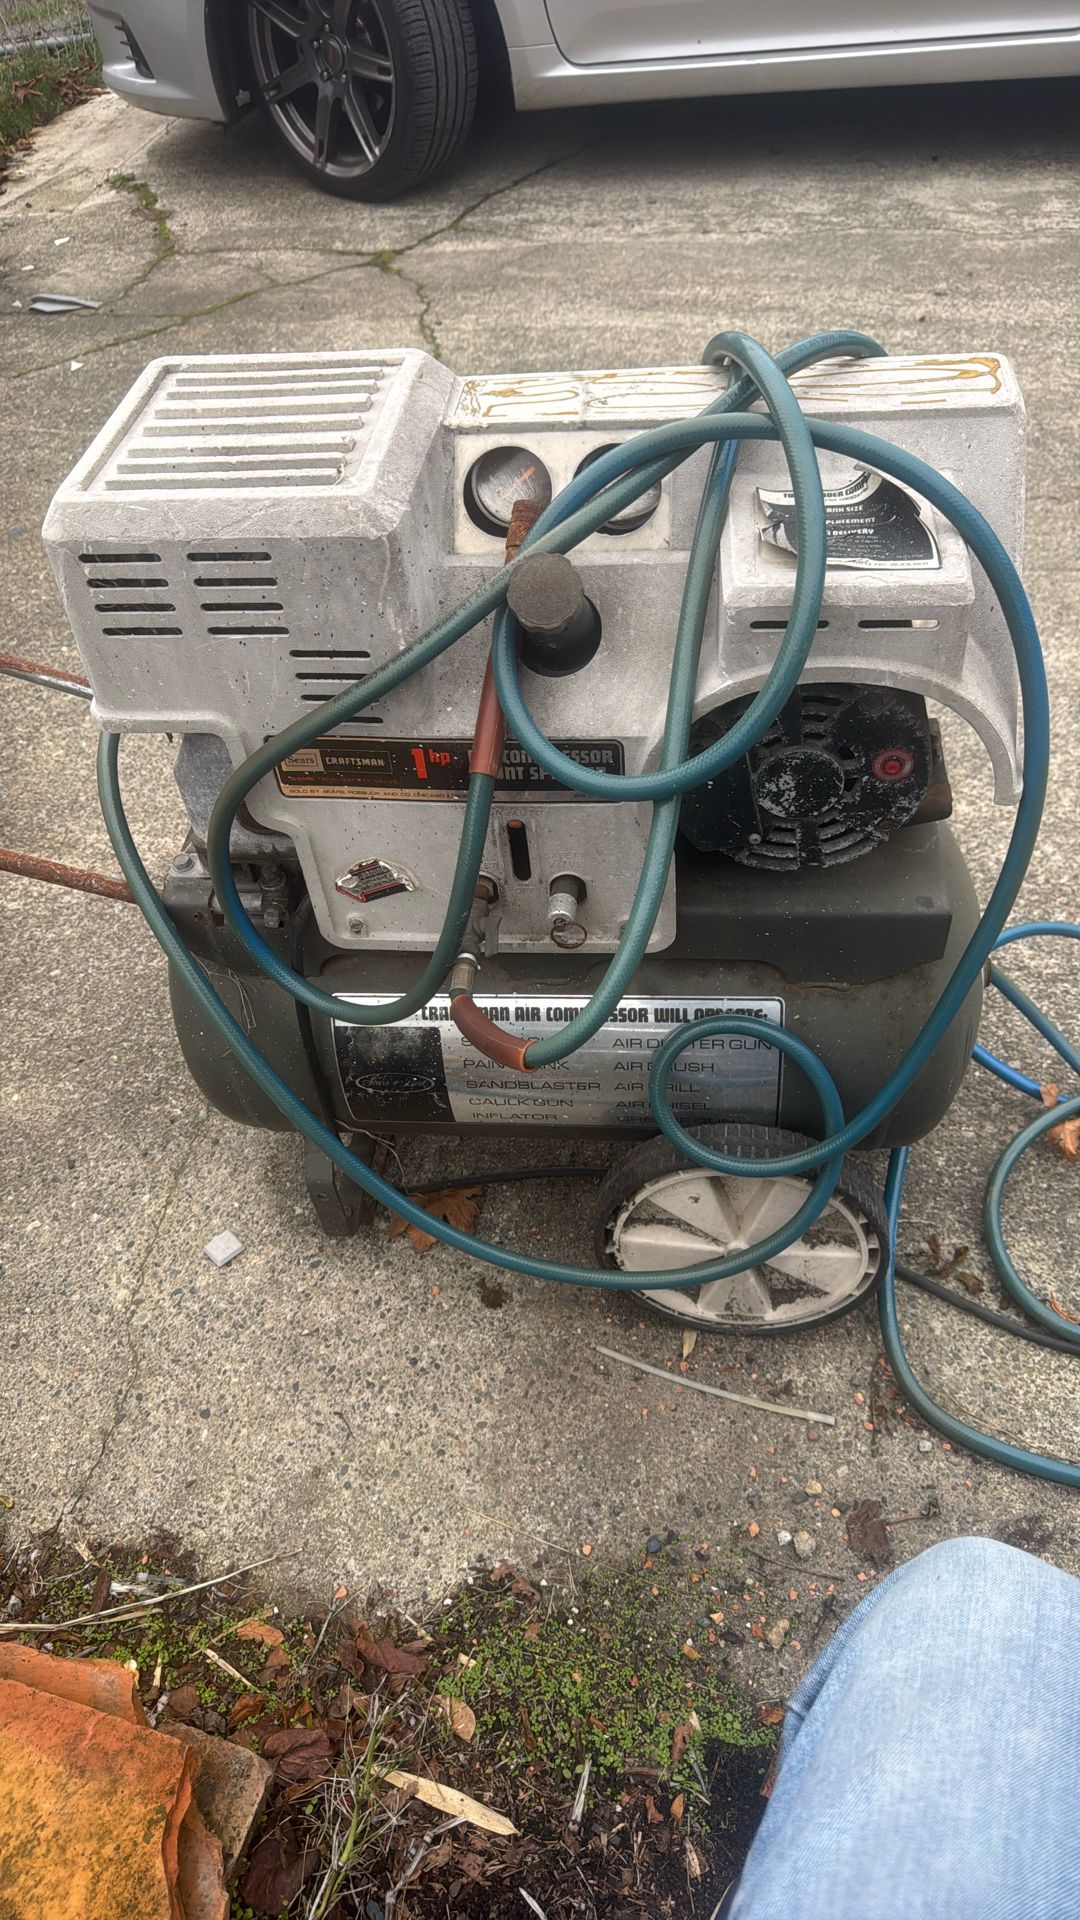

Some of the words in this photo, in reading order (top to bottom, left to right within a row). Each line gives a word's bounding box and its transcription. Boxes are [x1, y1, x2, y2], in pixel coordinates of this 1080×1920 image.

[832, 528, 875, 536] DELIVERY
[389, 644, 415, 665] MADE
[353, 670, 379, 690] CHINA
[287, 755, 315, 764] Sears
[325, 756, 385, 767] CRAFTSMAN
[421, 1006, 510, 1021] CRAAN
[514, 1006, 541, 1021] AIR
[546, 1006, 648, 1023] COMSSOR
[653, 1007, 690, 1023] WILL
[612, 1038, 643, 1049] AIR
[647, 1038, 725, 1050] DTER
[728, 1039, 772, 1050] GUN
[463, 1059, 506, 1070] PAIN
[613, 1061, 643, 1072] AIR
[647, 1062, 714, 1072] USH
[466, 1080, 601, 1091] SANDBLASTER
[614, 1083, 644, 1092] AIR
[666, 1083, 700, 1093] RILL
[469, 1097, 528, 1107] CAULK
[533, 1099, 573, 1108] GUN
[615, 1101, 645, 1109] AIR
[649, 1102, 714, 1111] HISEL
[472, 1112, 558, 1121] INFLATOR
